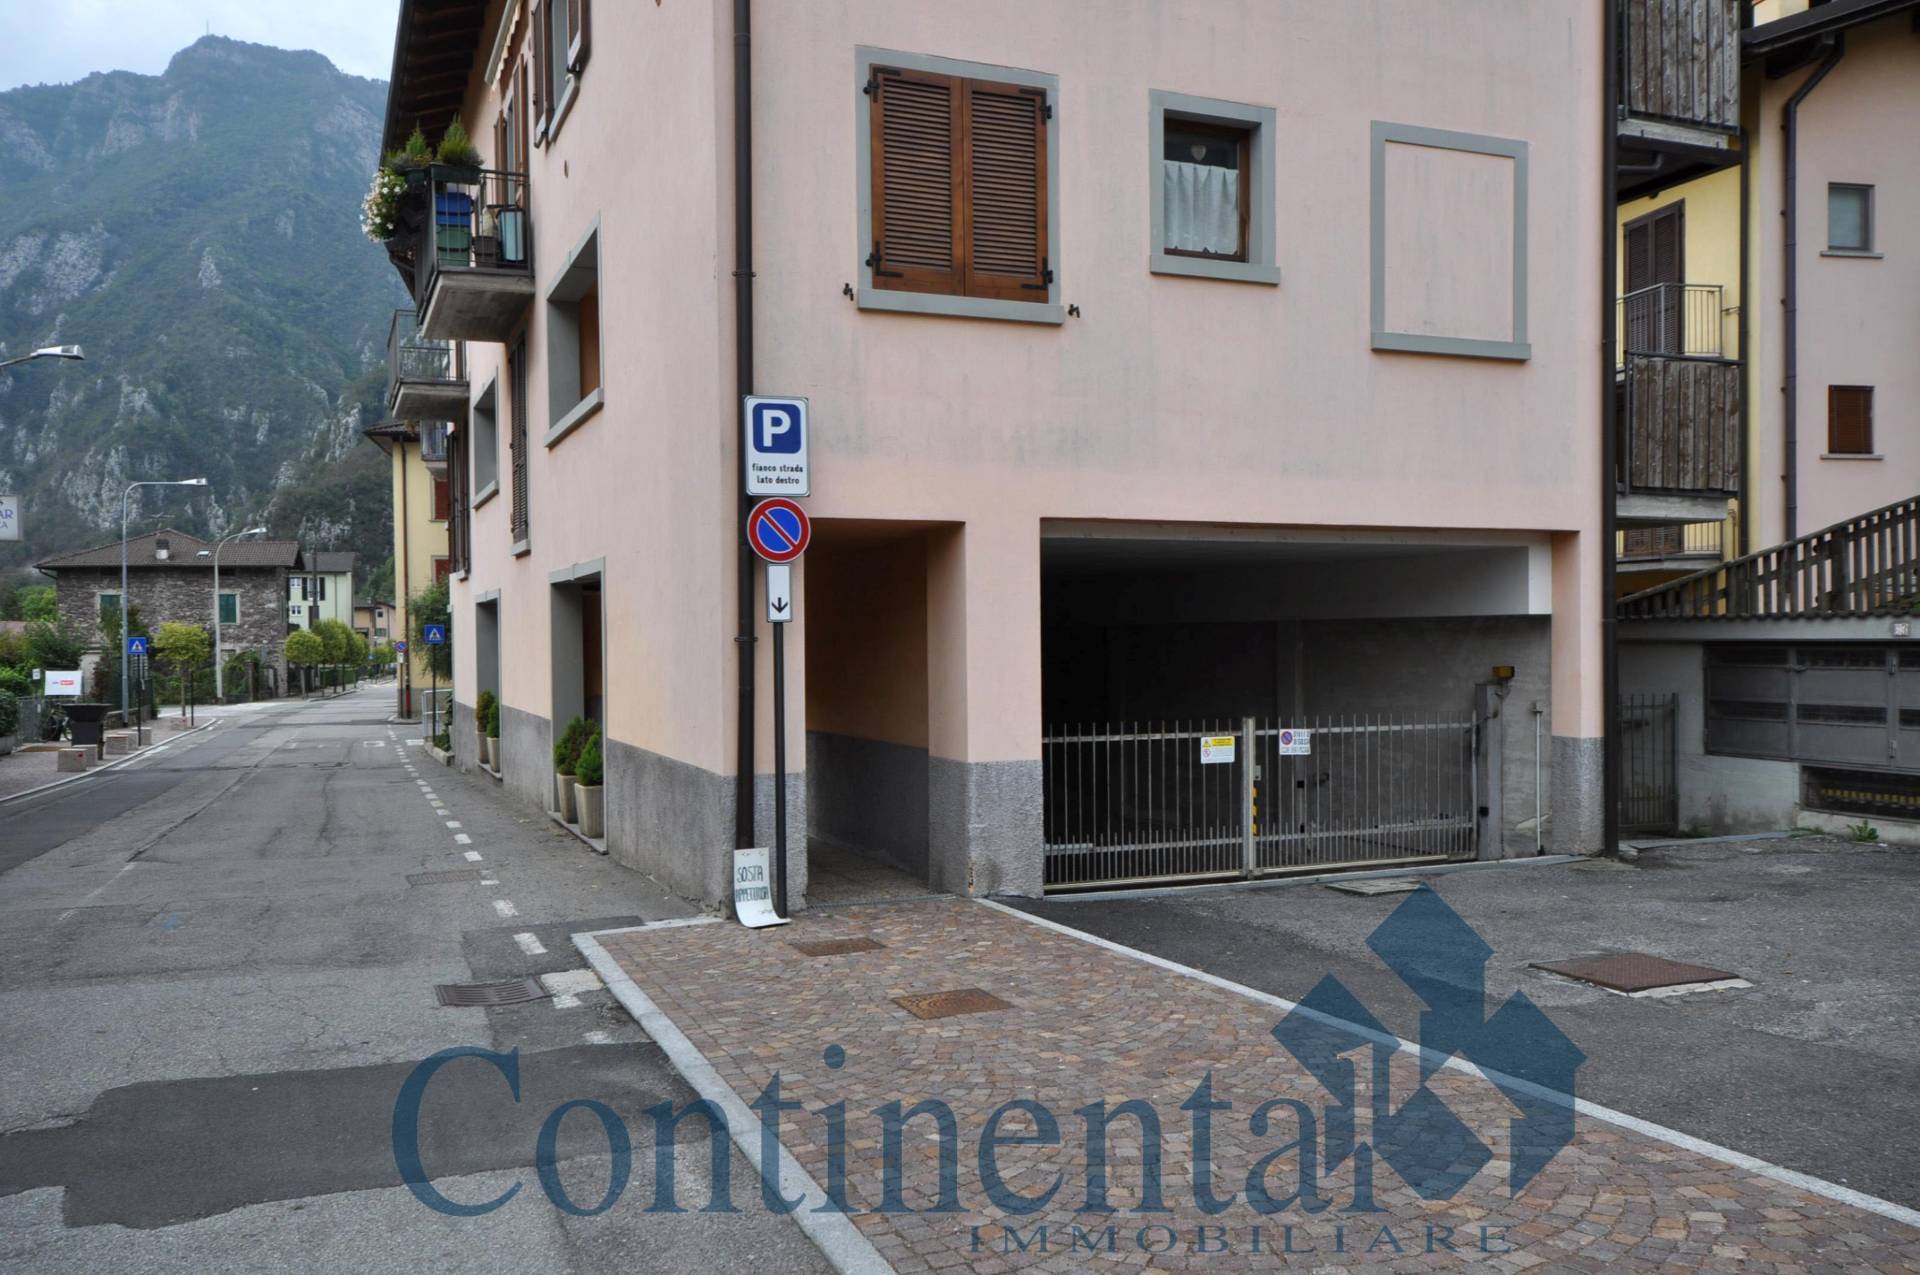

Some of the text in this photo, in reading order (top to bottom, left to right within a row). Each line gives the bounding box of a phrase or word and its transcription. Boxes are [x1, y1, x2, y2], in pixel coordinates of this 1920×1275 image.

[763, 409, 792, 447] P
[752, 463, 803, 473] fianco strada
[757, 475, 800, 485] lato destro
[736, 865, 764, 883] SOSTA
